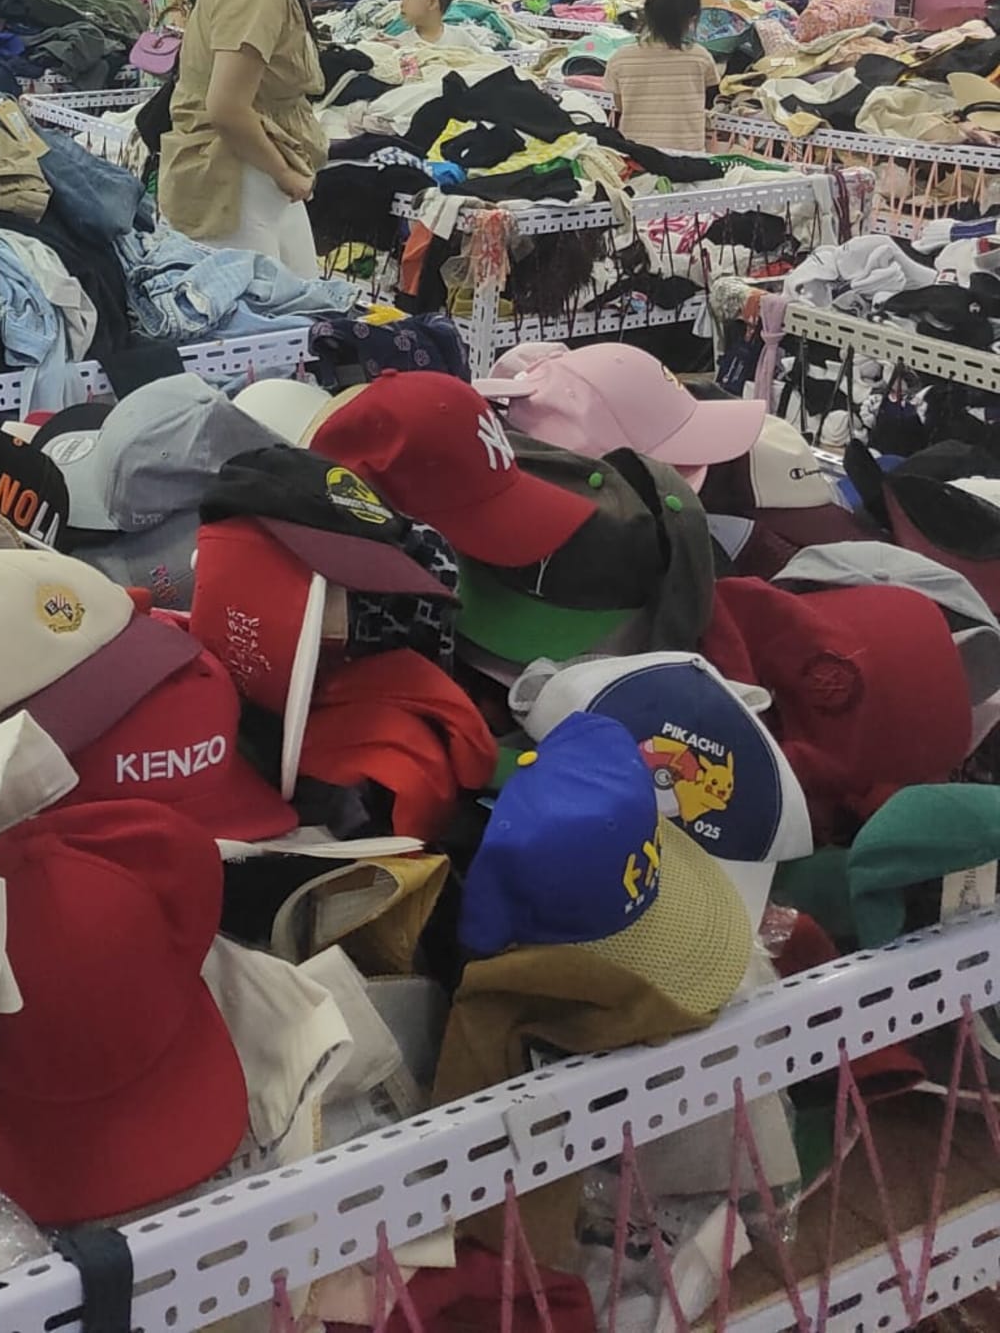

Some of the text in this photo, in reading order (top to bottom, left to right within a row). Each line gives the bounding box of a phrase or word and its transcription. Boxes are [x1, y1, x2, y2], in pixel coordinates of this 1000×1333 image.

[661, 721, 725, 758] PIKACHU
[116, 735, 226, 783] KENZO
[693, 820, 722, 840] 025
